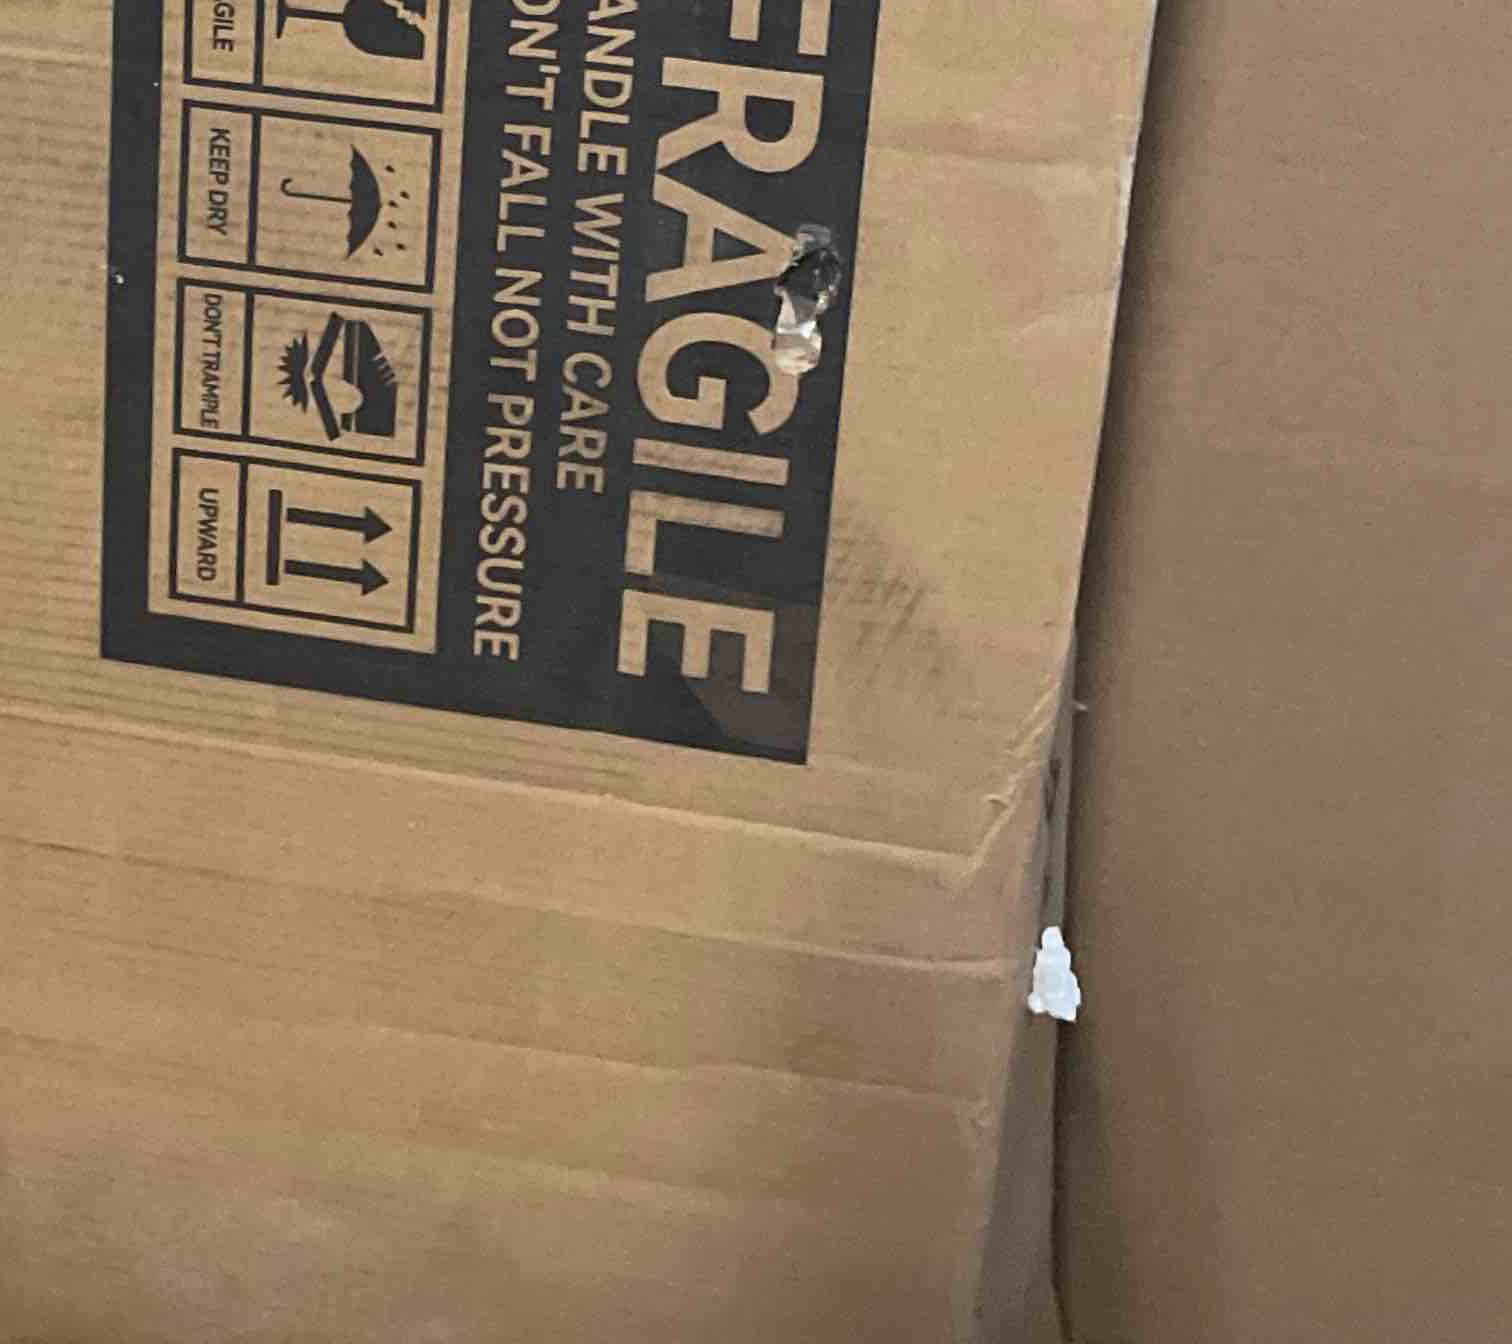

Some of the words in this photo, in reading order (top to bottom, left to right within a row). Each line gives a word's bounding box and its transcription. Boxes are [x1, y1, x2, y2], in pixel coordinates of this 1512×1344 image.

[207, 190, 231, 236] DRY
[209, 127, 231, 187] KEEP
[496, 123, 553, 253] FALL
[490, 266, 544, 383] NOT
[566, 192, 625, 337] WITH
[556, 351, 613, 495] CARE
[196, 487, 219, 582] UPWARD
[472, 392, 536, 661] PRESSURE
